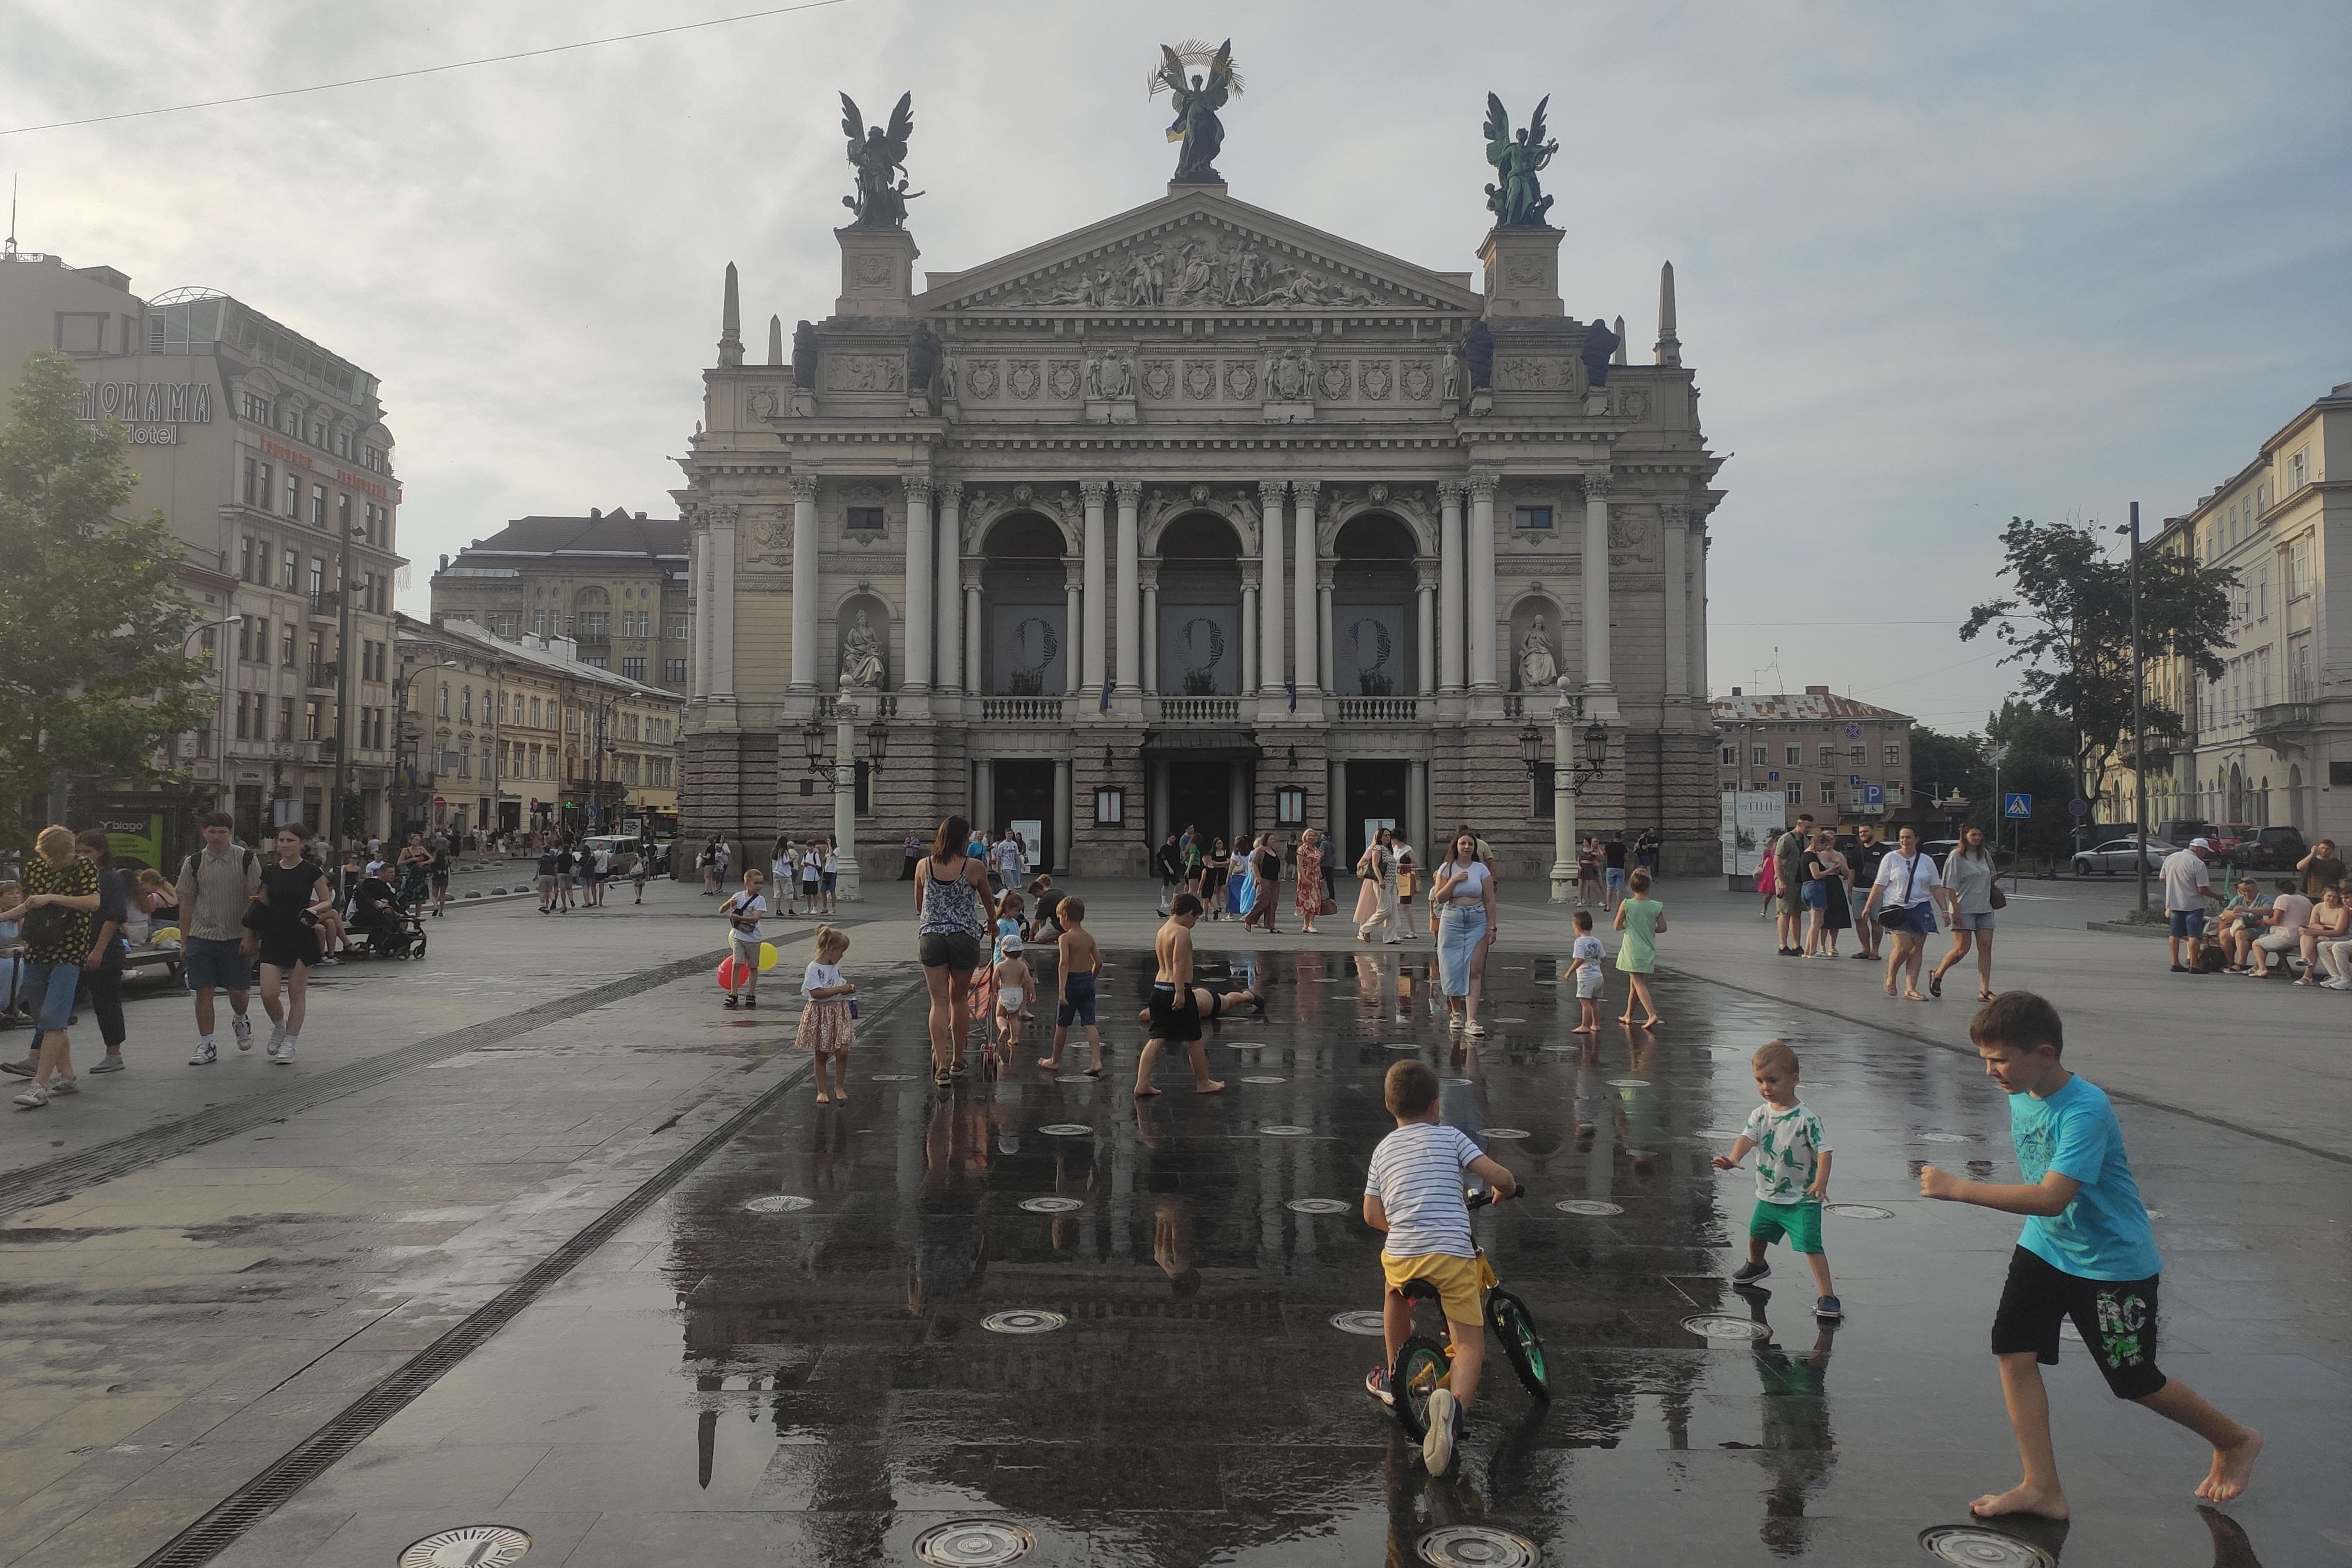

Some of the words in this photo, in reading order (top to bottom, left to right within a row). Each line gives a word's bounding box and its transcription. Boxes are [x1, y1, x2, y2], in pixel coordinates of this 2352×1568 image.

[75, 382, 211, 422] NORAMA
[1869, 786, 1880, 802] P
[112, 820, 144, 832] blago
